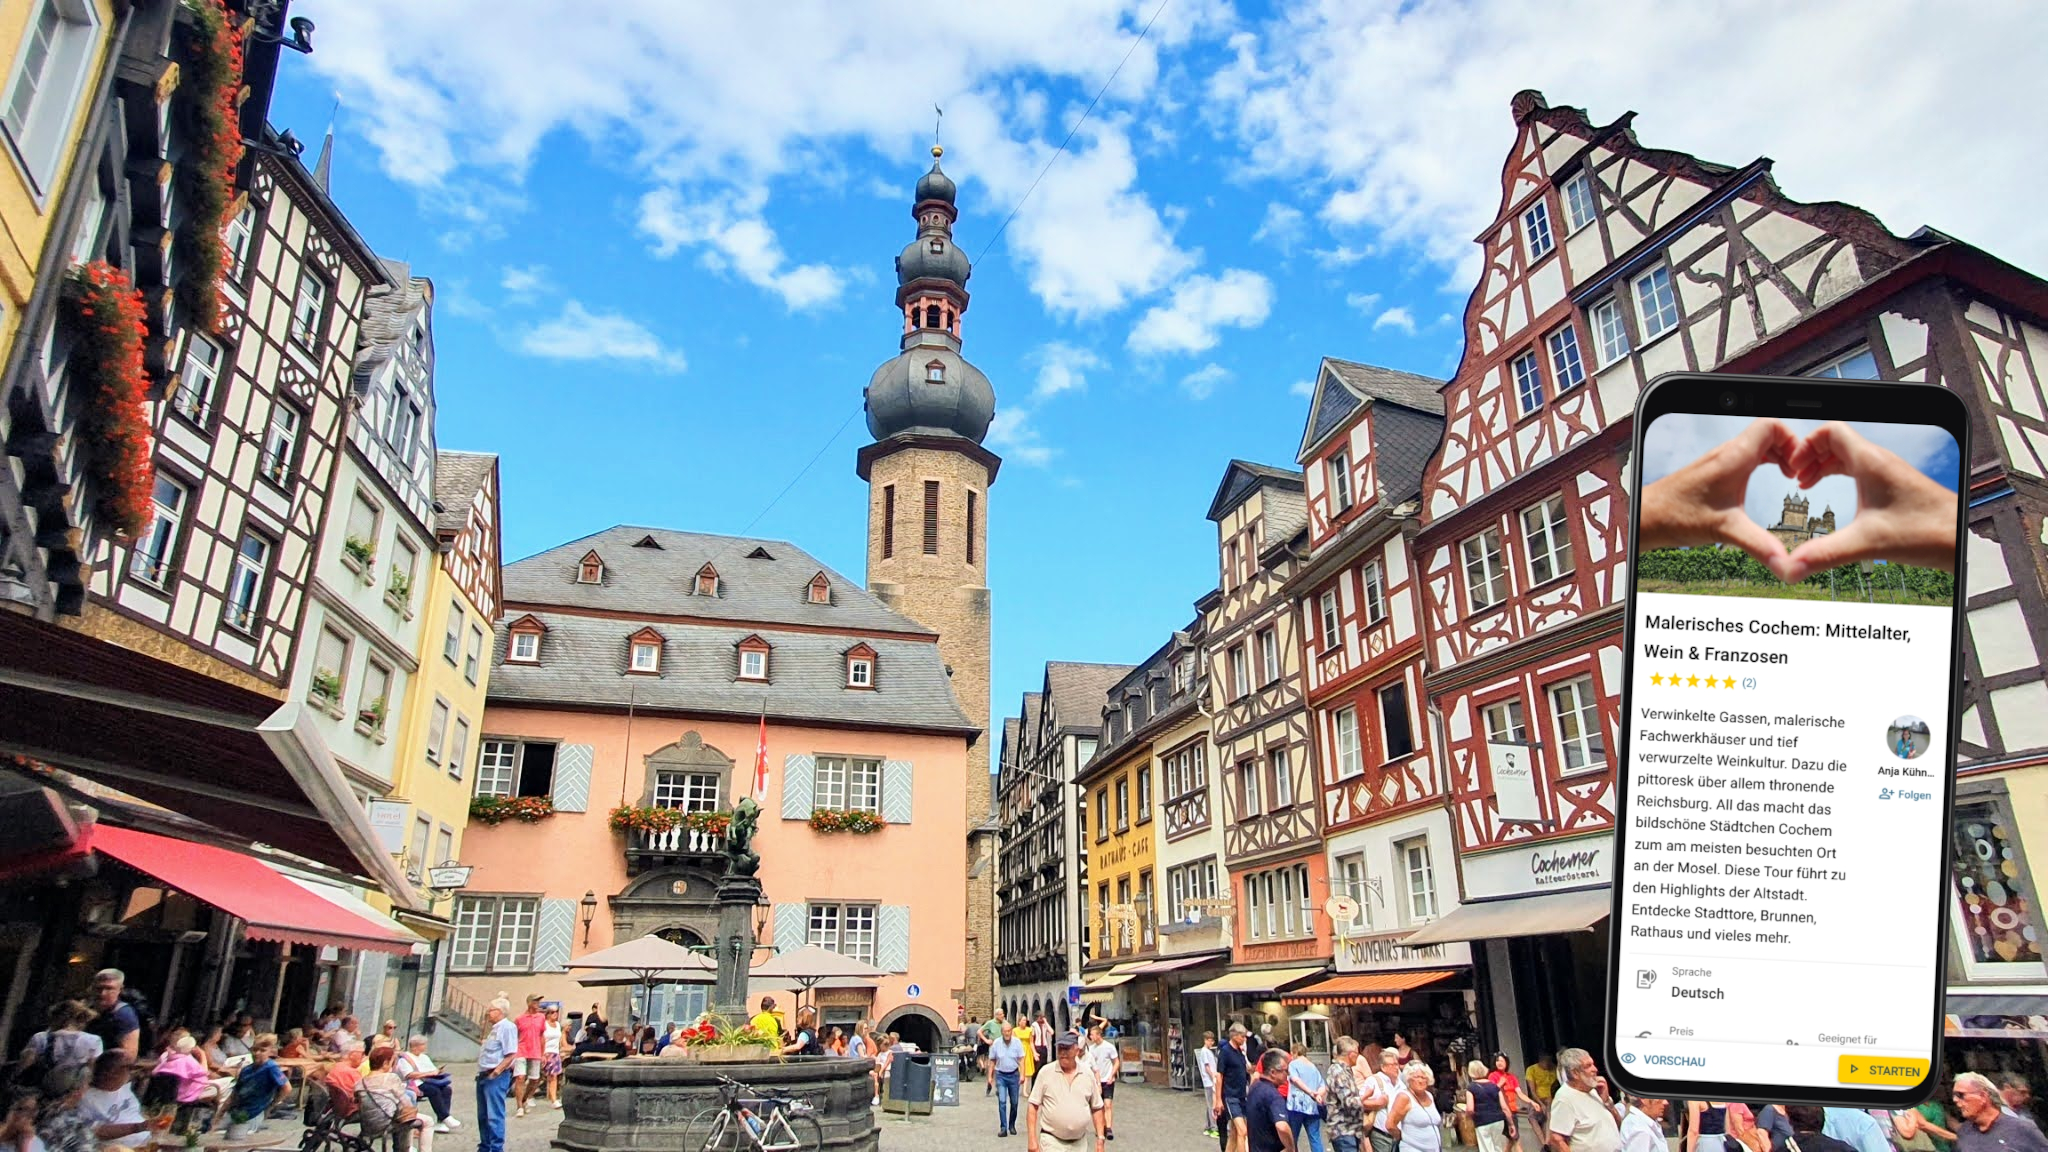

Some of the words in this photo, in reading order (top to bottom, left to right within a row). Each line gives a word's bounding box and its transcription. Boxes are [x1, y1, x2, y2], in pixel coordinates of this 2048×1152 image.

[1645, 614, 1744, 633] Malerisches
[1748, 619, 1820, 637] Cochem:
[1825, 622, 1911, 643] Mittelalter,
[1644, 643, 1684, 659] Wein
[1688, 645, 1700, 660] &
[1704, 646, 1789, 664] Franzosen
[1742, 677, 1757, 690] (2)
[1640, 707, 1716, 722] Verwinkelte
[1719, 710, 1771, 726] Gassen,
[1774, 714, 1846, 728] malerische
[1639, 729, 1747, 745] Fachwerkhäuser
[1749, 734, 1774, 746] und
[1776, 736, 1799, 748] tief
[1638, 753, 1713, 765] verwurzelte
[1716, 754, 1787, 769] Weinkultur.
[1791, 757, 1824, 771] Dazu
[1827, 759, 1847, 772] die
[1877, 766, 1900, 777] Anja
[1902, 767, 1935, 777] Kühn...
[1637, 773, 1694, 786] pittoresk
[1697, 775, 1727, 788] über
[1730, 777, 1766, 790] allem
[1769, 779, 1835, 793] thronende
[1636, 794, 1712, 811] Reichsburg.
[1715, 798, 1733, 810] All
[1736, 799, 1760, 812] das
[1763, 801, 1805, 814] macht
[1807, 802, 1832, 815] das
[1898, 789, 1932, 801] Folgen
[1635, 815, 1706, 830] bildschöne
[1709, 819, 1775, 834] Städtchen
[1778, 822, 1833, 836] Cochem
[1634, 840, 1662, 850] zum
[1666, 842, 1687, 851] am
[1690, 842, 1742, 854] meisten
[1745, 842, 1813, 857] besuchten
[1816, 846, 1837, 858] Ort
[1531, 849, 1600, 874] Cochemer
[1633, 861, 1650, 871] an
[1652, 859, 1675, 872] der
[1677, 861, 1721, 874] Mosel.
[1724, 863, 1761, 876] Diese
[1763, 865, 1794, 877] Tour
[1796, 866, 1828, 879] führt
[1830, 870, 1846, 880] zu
[1535, 868, 1600, 885] Kaffeerösterei
[1632, 880, 1657, 893] den
[1660, 882, 1726, 898] Highlights
[1728, 885, 1751, 898] der
[1753, 887, 1808, 901] Altstadt.
[1631, 903, 1691, 918] Entdecke
[1694, 906, 1757, 922] Stadttore,
[1760, 909, 1817, 925] Brunnen,
[1630, 924, 1684, 938] Rathaus
[1687, 928, 1711, 940] und
[1714, 928, 1752, 941] vieles
[1755, 931, 1791, 943] mehr.
[1350, 938, 1398, 965] SOUVENIRS
[1672, 966, 1712, 978] Sprache
[1671, 986, 1725, 1000] Deutsch
[1669, 1026, 1694, 1036] Preis
[1818, 1033, 1862, 1045] Geeignet
[1864, 1034, 1878, 1044] für
[1643, 1054, 1706, 1067] VORSCHAU
[1869, 1064, 1920, 1077] STARTEN
